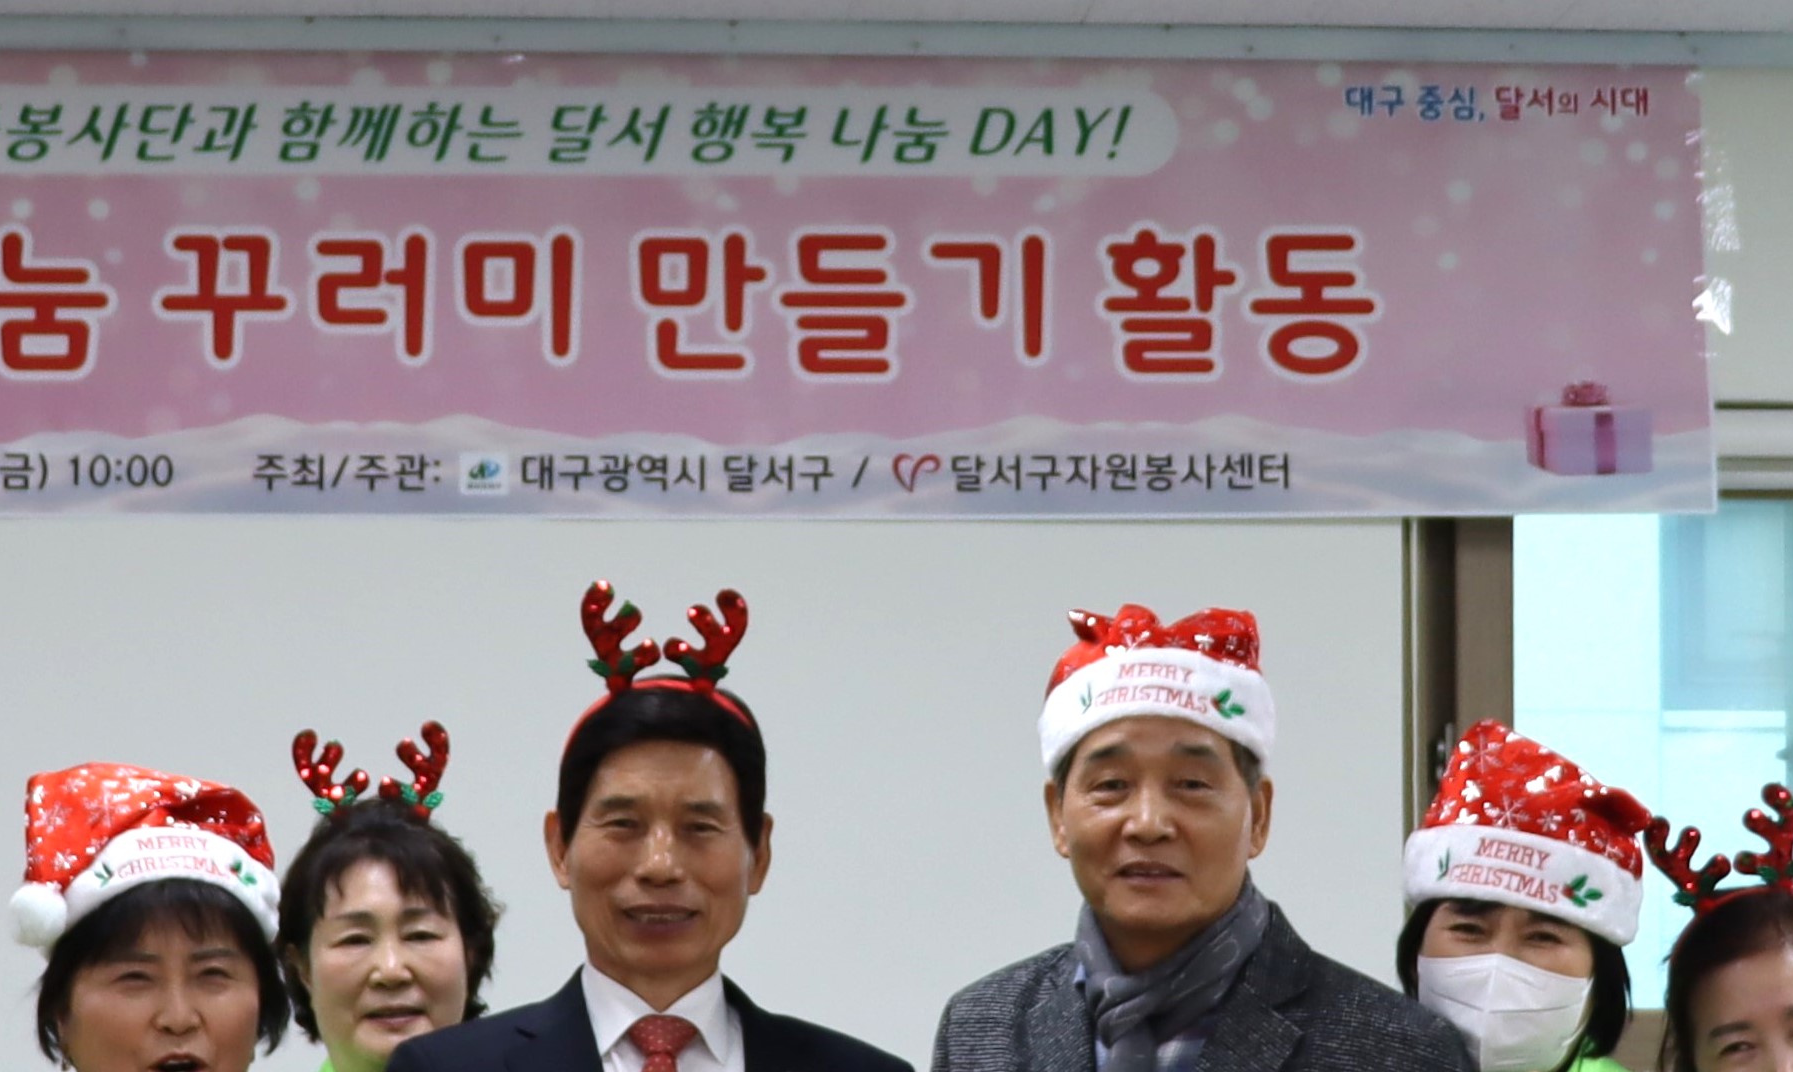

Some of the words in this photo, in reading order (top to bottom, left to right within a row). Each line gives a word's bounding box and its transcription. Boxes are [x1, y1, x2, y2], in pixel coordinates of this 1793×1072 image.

[1344, 85, 1405, 118] 대구
[1417, 85, 1486, 122] 중심,
[1494, 86, 1579, 121] 달서의
[1590, 86, 1650, 117] 시대
[279, 101, 522, 162] 함께하는
[549, 104, 671, 162] 달서
[691, 102, 807, 163] 행복
[831, 105, 948, 163] 나눔
[970, 105, 1132, 159] DAY!
[162, 234, 574, 360] 꾸러미
[640, 234, 1045, 375] 만들기
[1105, 230, 1376, 375] 활동
[70, 455, 173, 487] 10:00
[254, 455, 440, 492] 주최/주관:
[521, 455, 705, 493] 대구광역시
[724, 455, 834, 492] 달서구
[852, 457, 868, 488] /
[952, 454, 1289, 492] 달서구자원봉사센터
[1118, 662, 1195, 684] MERRY
[1475, 837, 1551, 871] MERRY
[1449, 863, 1559, 904] CHRISTMAS
